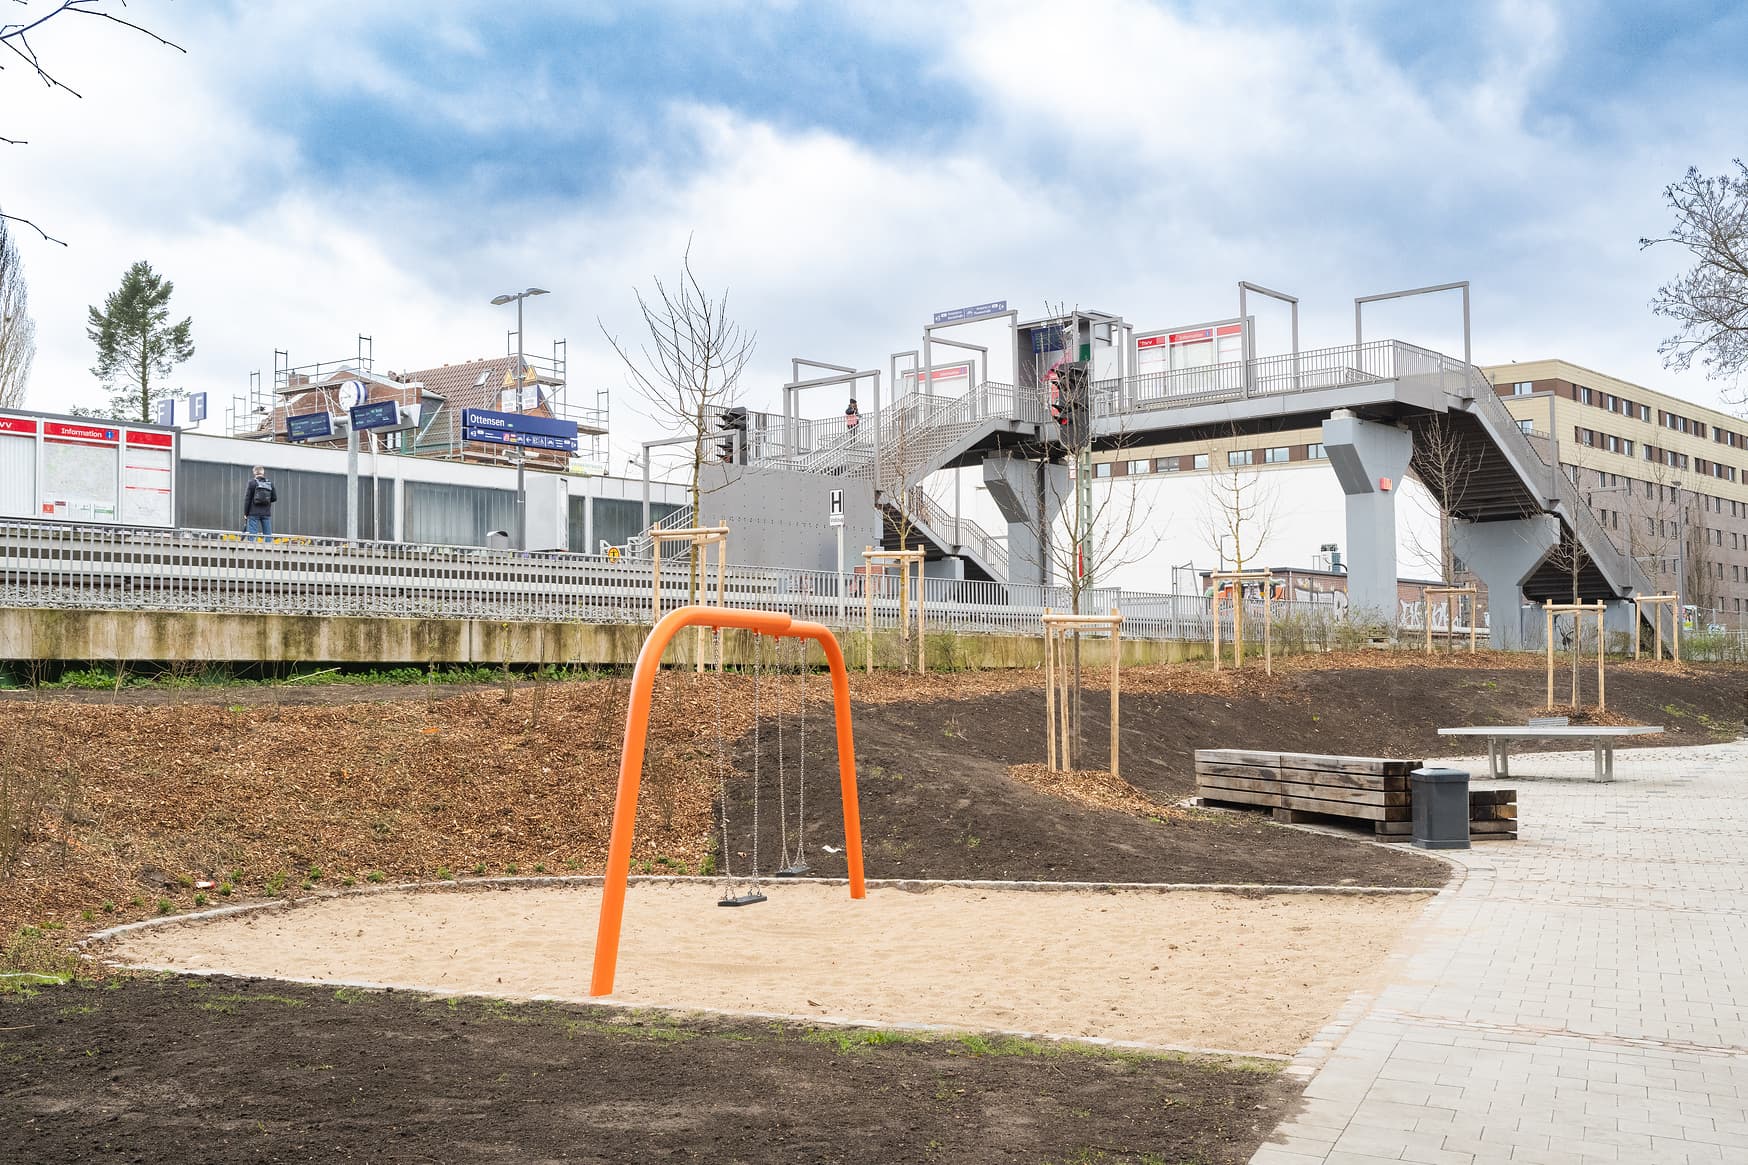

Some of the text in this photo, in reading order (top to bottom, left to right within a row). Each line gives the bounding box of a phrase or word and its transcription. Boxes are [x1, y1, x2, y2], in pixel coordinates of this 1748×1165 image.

[158, 404, 165, 424] F
[195, 396, 203, 417] F
[470, 414, 505, 427] Ottensen
[61, 428, 102, 438] Information
[831, 491, 842, 513] H
